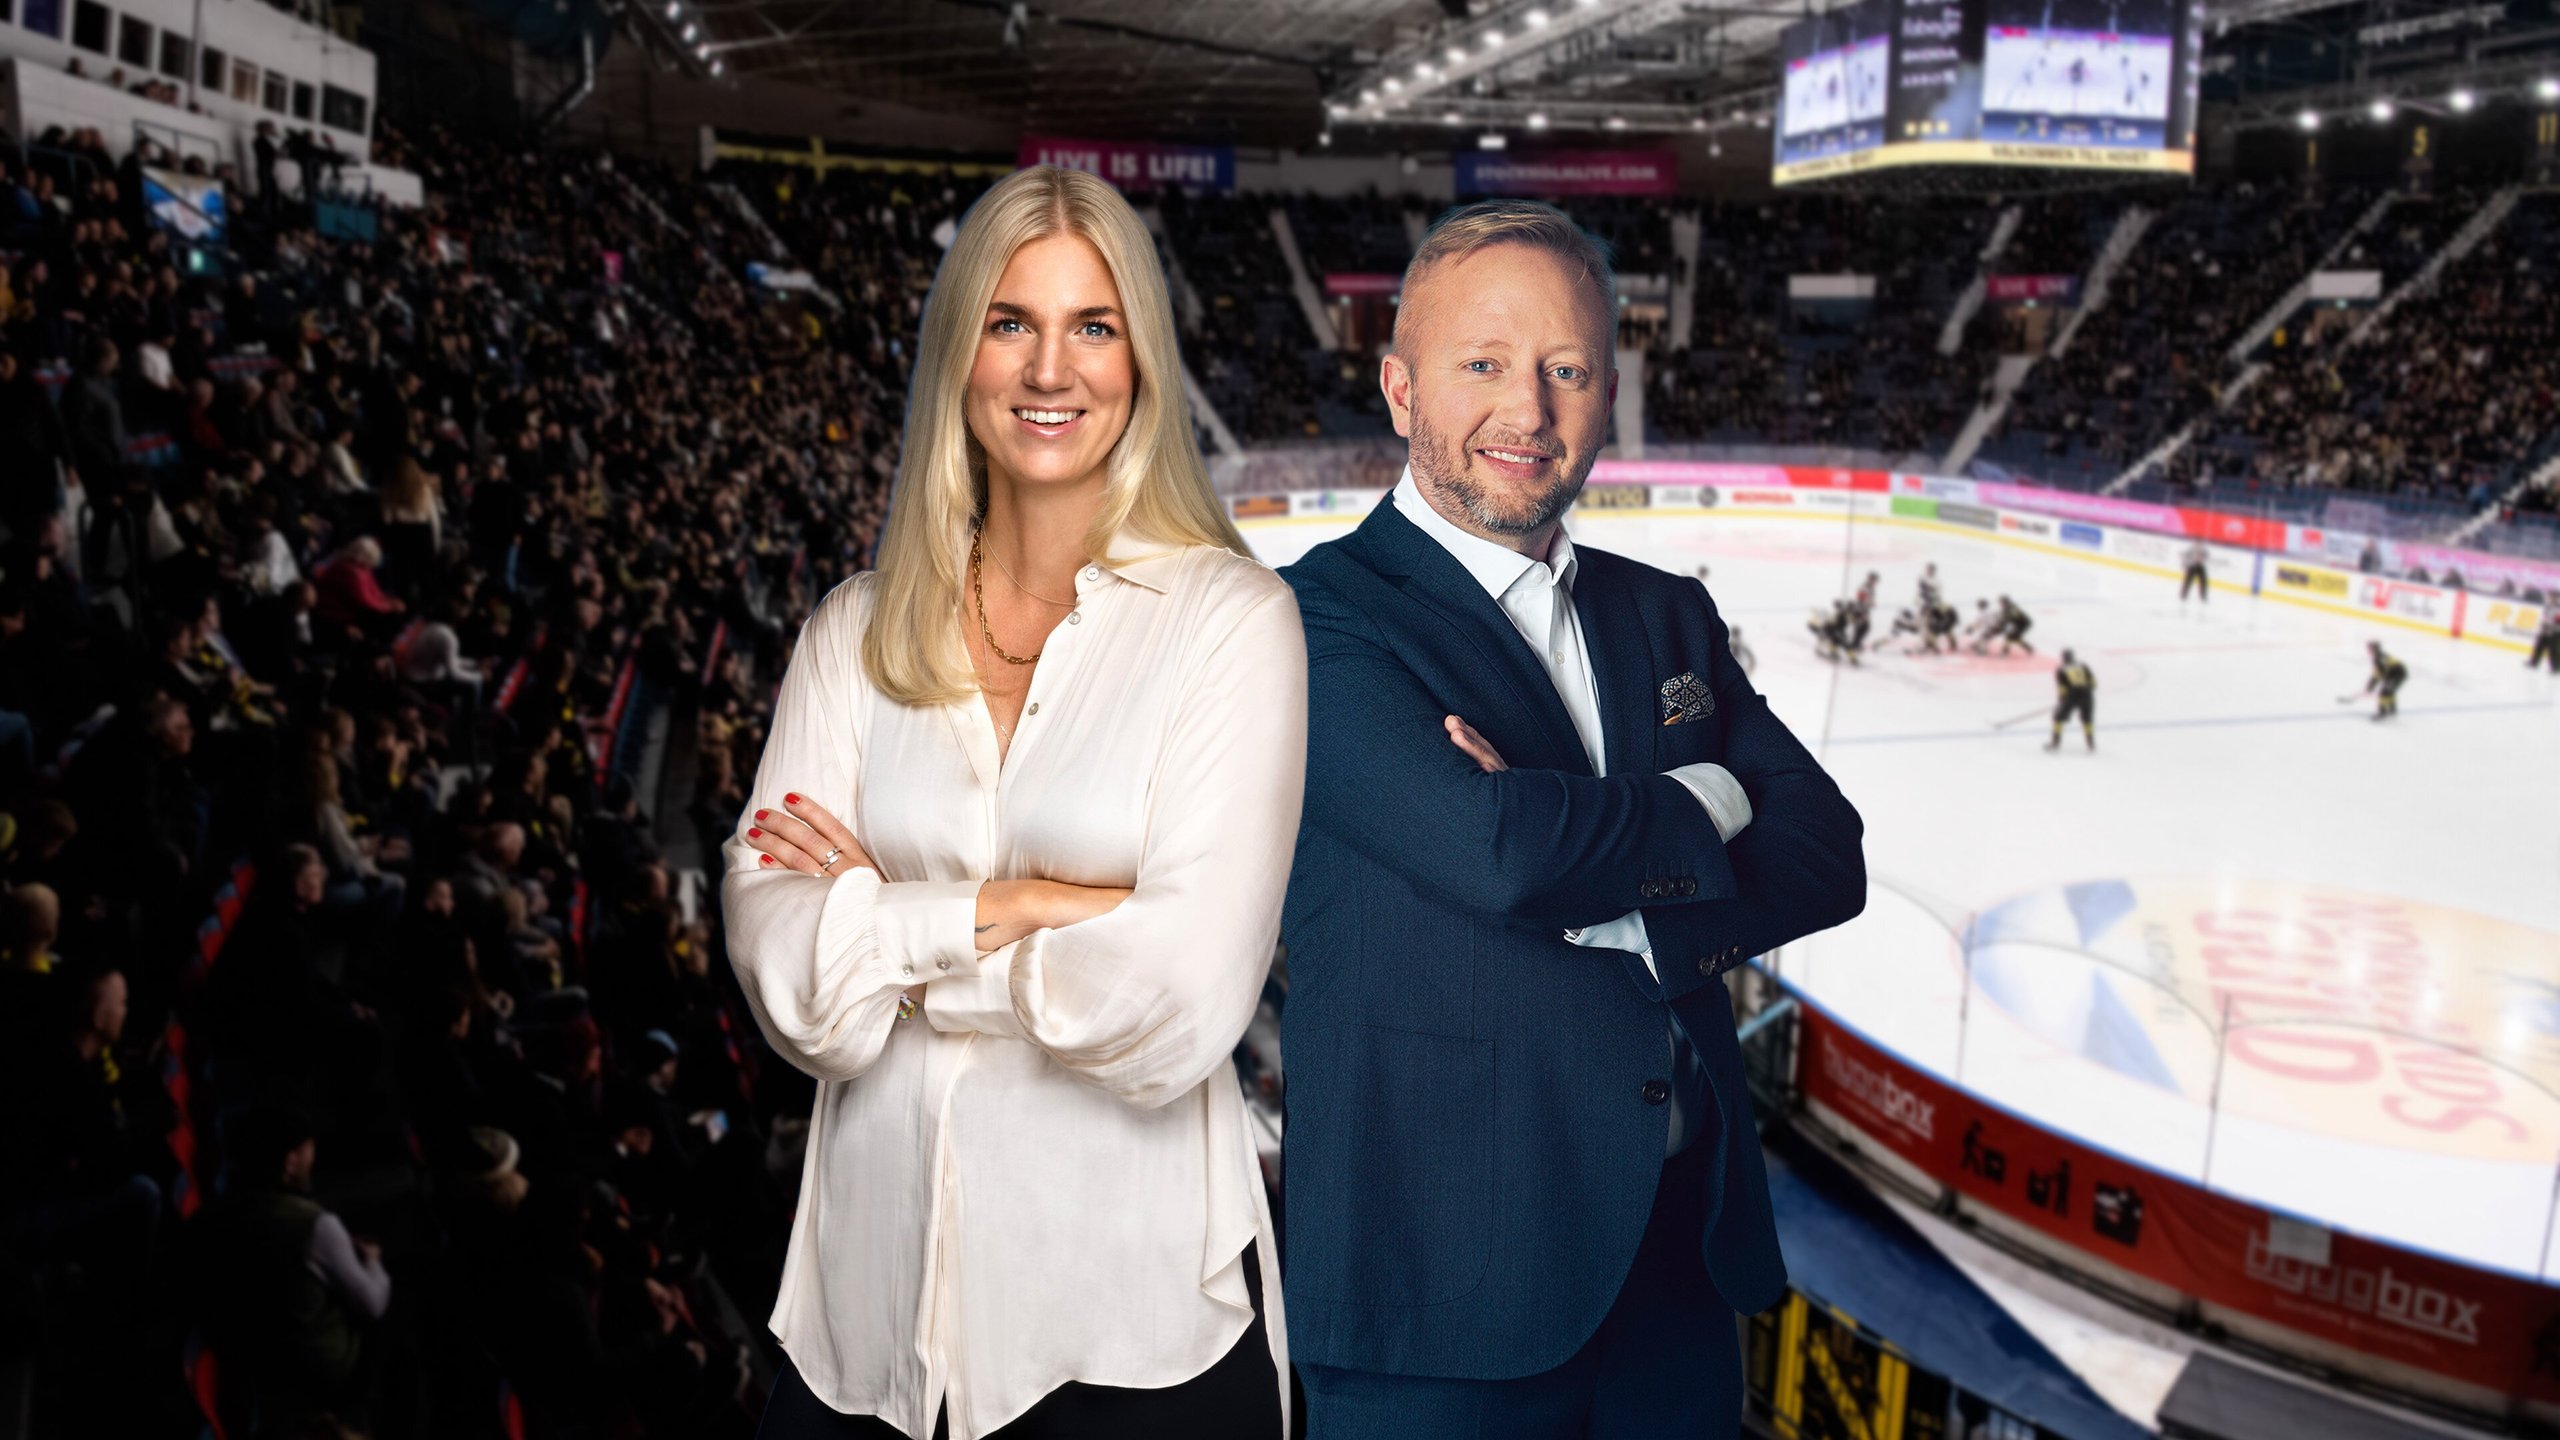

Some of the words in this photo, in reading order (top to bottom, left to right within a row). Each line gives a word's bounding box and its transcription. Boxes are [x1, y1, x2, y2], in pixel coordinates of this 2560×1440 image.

[1039, 149, 1100, 177] LIVE
[1110, 152, 1139, 178] IS
[1149, 154, 1215, 181] LIFE!
